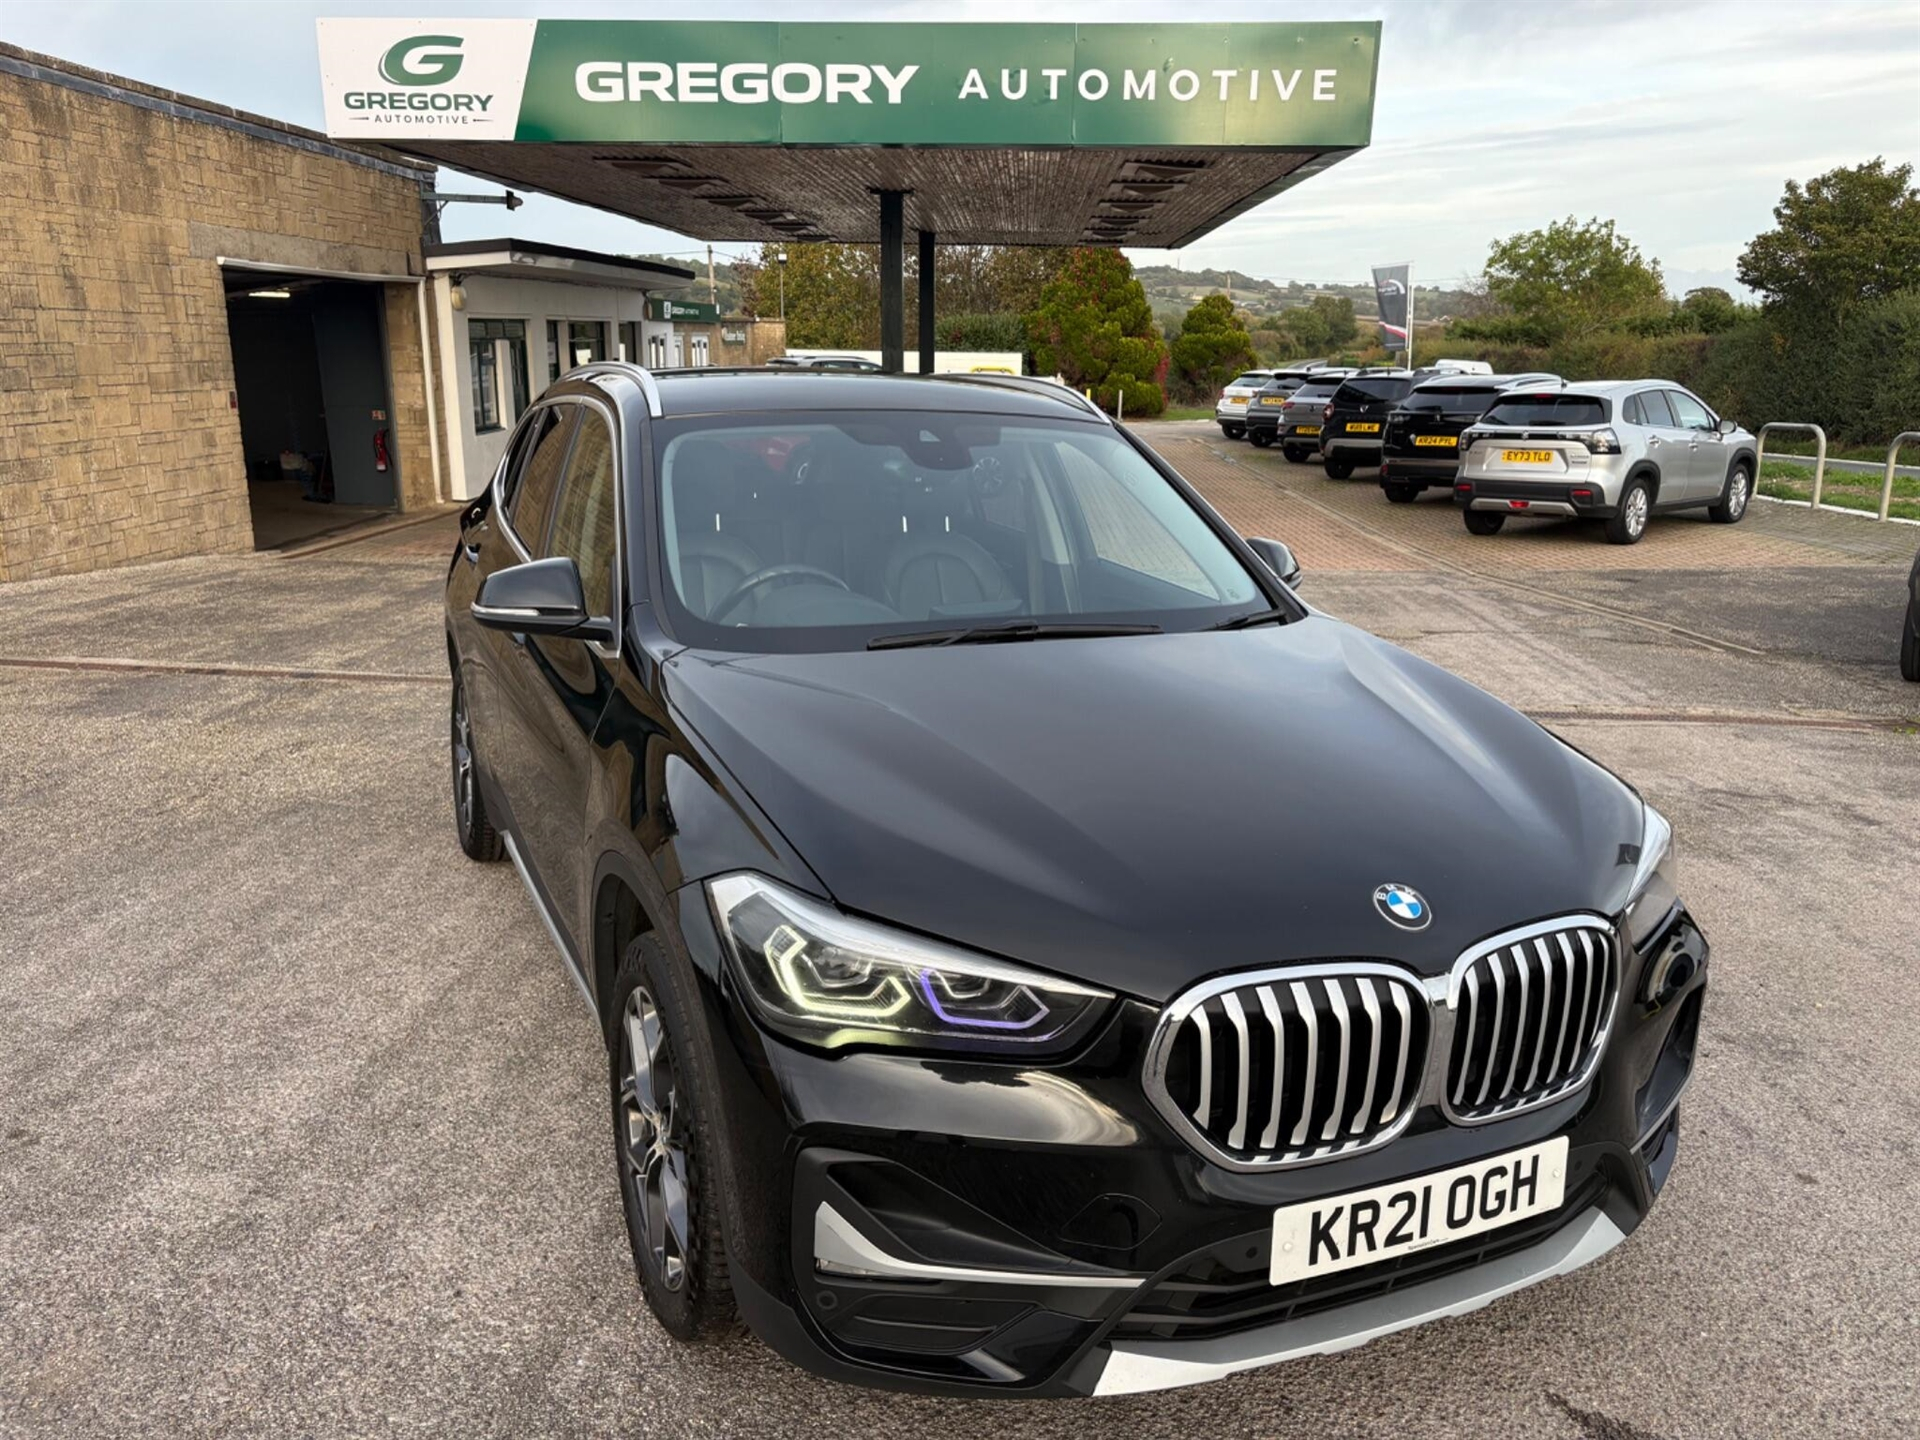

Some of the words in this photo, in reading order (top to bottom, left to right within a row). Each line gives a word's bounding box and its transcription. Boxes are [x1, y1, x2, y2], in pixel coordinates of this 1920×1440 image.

[378, 35, 464, 86] G
[575, 61, 919, 104] GREGORY
[959, 67, 1337, 102] AUTOMOTIVE
[344, 92, 494, 112] GREGORY
[374, 114, 469, 125] AUTOMOTIVE
[1506, 450, 1531, 462] EY73
[1532, 451, 1552, 463] TLO
[1376, 884, 1416, 901] BMW
[1308, 1184, 1433, 1267] KR21
[1446, 1154, 1540, 1231] OGH
